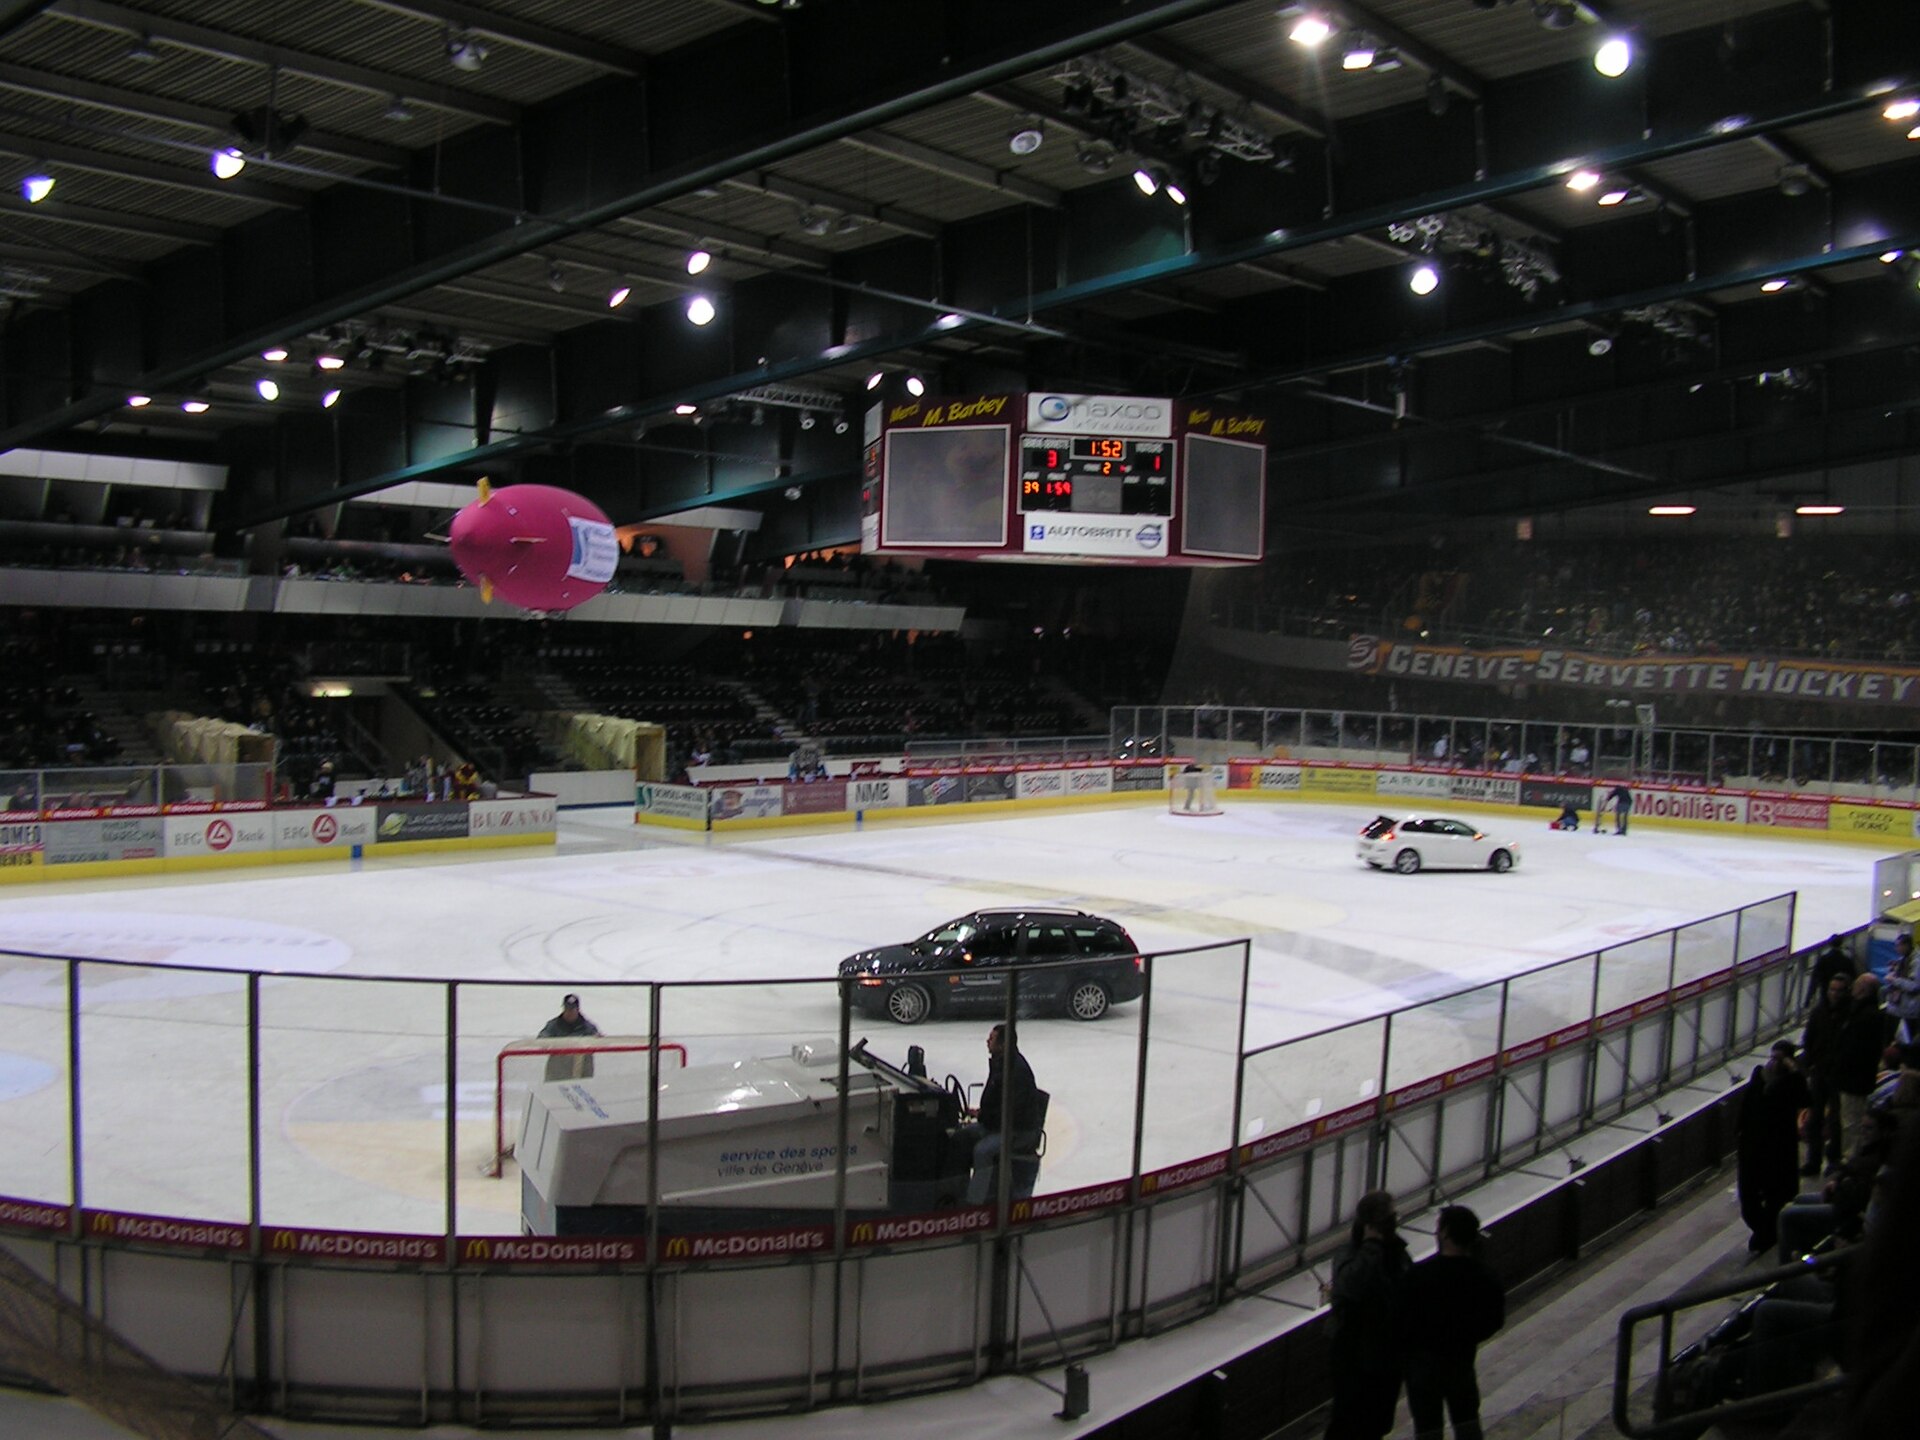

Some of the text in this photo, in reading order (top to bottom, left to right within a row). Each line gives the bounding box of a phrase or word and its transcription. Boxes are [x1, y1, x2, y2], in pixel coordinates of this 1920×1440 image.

[1046, 449, 1058, 469] 3
[1091, 440, 1123, 458] 1:52
[1102, 461, 1112, 476] 2
[1740, 659, 1916, 701] HOCKEY
[1632, 793, 1738, 822] Mobilière
[719, 1148, 775, 1163] service
[779, 1145, 806, 1159] des
[750, 1162, 767, 1175] de
[772, 1159, 824, 1175] Genève
[116, 1216, 245, 1248] McDonald's
[876, 1210, 991, 1241] McDonald's
[300, 1234, 438, 1259] McDonald's
[493, 1240, 635, 1261] McDonald's
[692, 1231, 825, 1257] McDonald's
